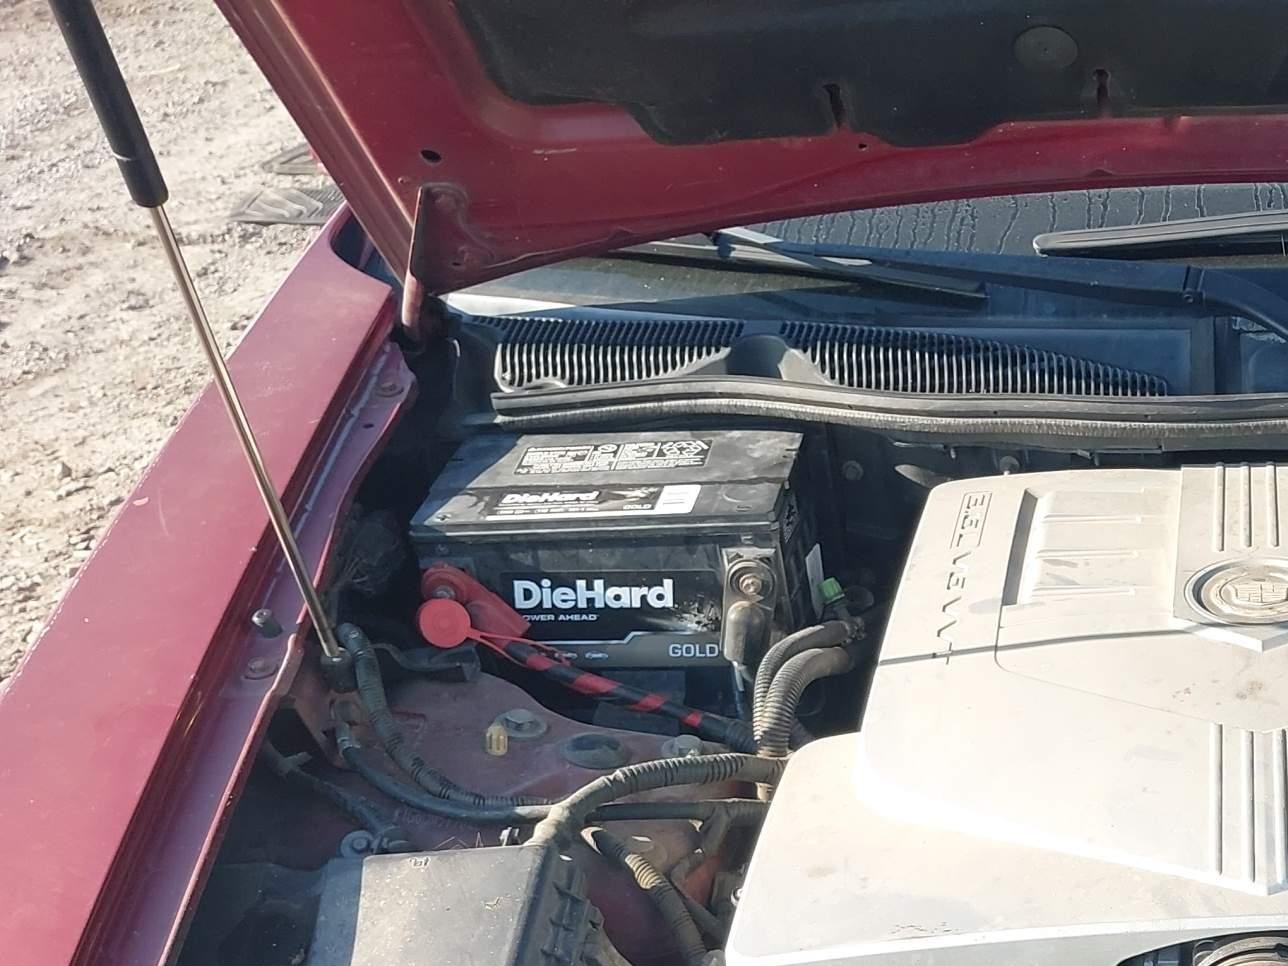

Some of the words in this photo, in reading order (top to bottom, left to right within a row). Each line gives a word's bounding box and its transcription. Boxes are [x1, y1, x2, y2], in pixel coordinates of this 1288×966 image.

[501, 490, 600, 504] DieHard
[512, 578, 674, 610] DieHard
[522, 614, 556, 622] OWER
[558, 614, 597, 622] AHEAD
[668, 643, 720, 658] GOLD
